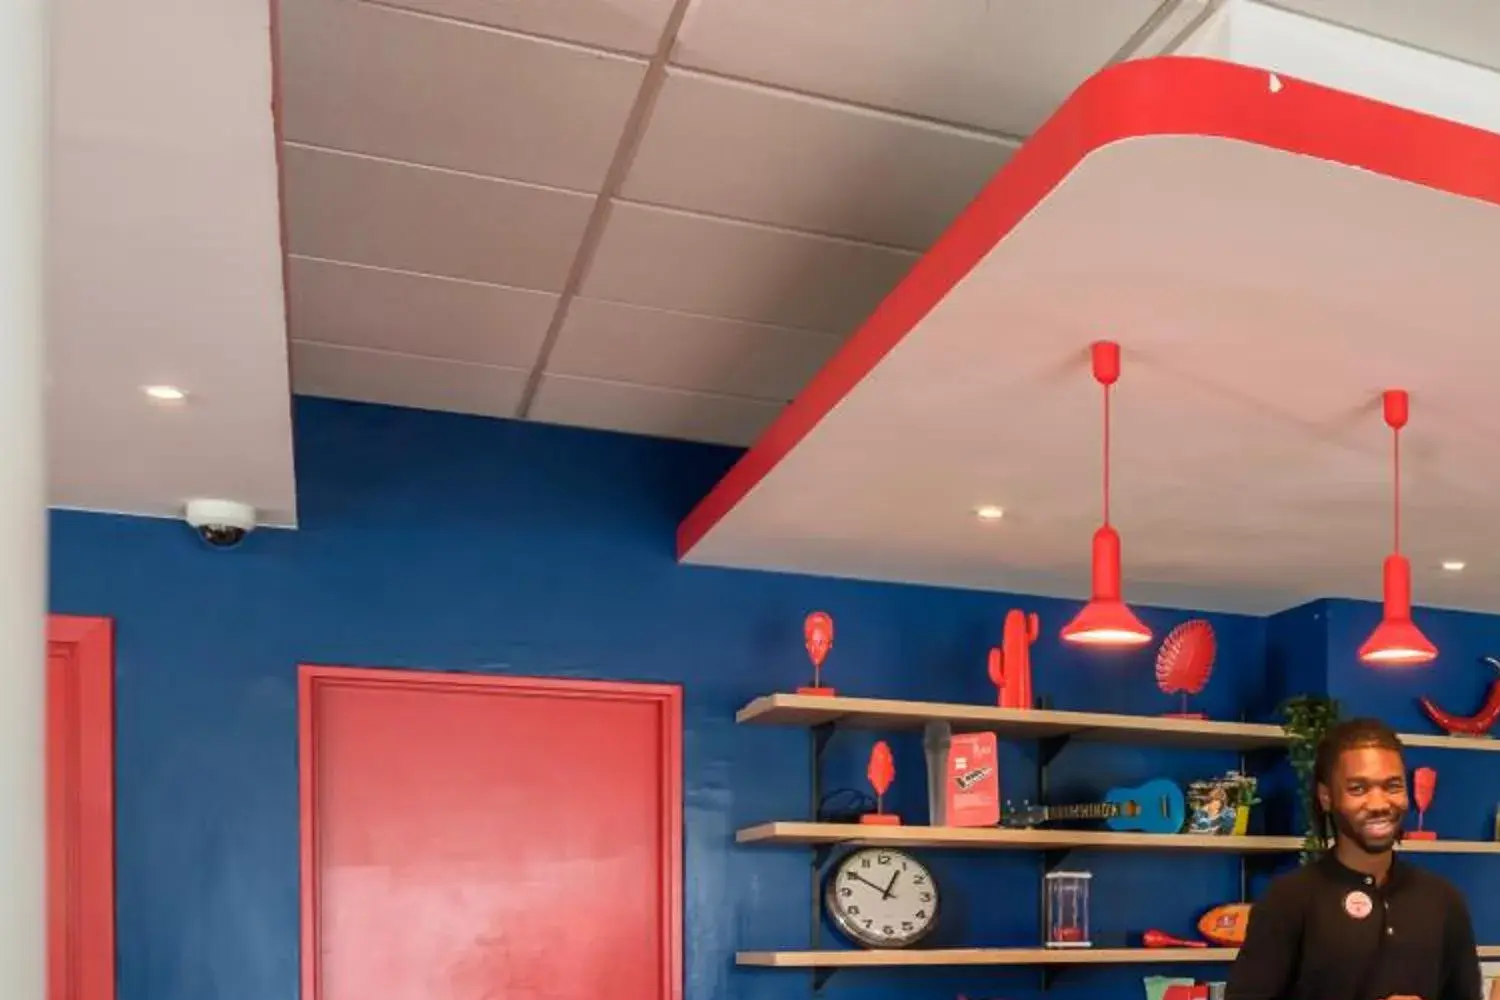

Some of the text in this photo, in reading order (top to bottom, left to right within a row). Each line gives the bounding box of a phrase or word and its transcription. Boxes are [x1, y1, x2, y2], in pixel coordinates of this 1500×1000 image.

[861, 859, 871, 868] 11
[877, 855, 892, 865] 12
[902, 862, 907, 871] 1
[913, 874, 925, 885] 2
[841, 887, 853, 898] 9
[920, 891, 932, 902] 3
[847, 905, 860, 915] 8
[915, 910, 925, 919] 4
[861, 919, 874, 928] 7
[901, 921, 914, 931] 5
[882, 925, 894, 935] 6
